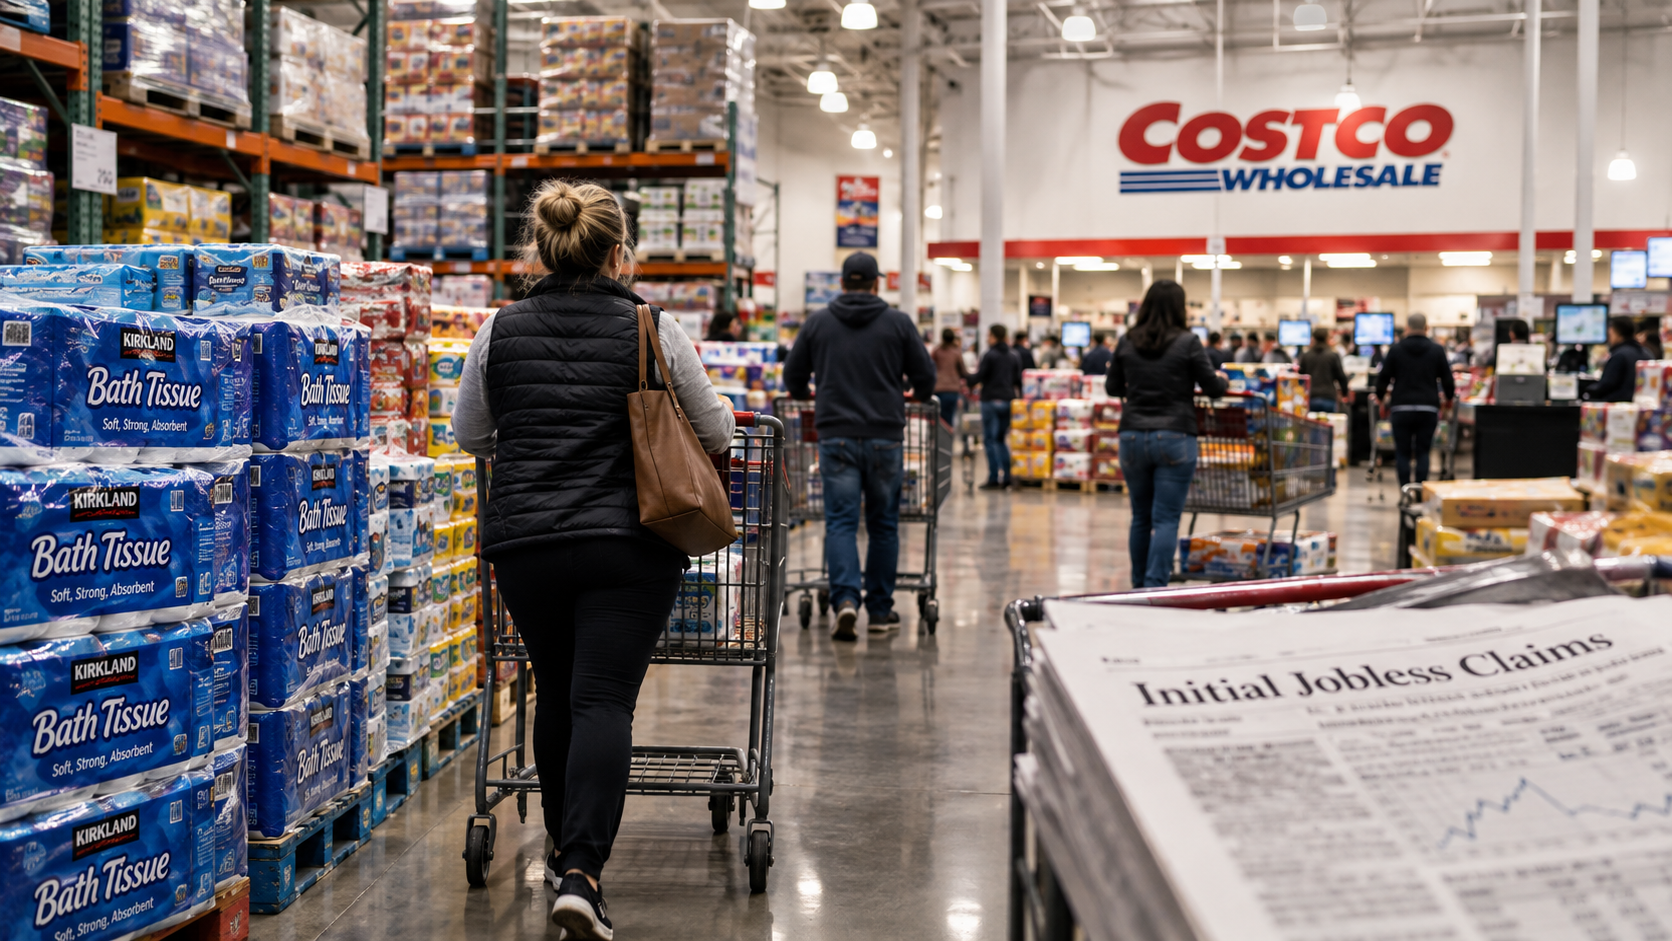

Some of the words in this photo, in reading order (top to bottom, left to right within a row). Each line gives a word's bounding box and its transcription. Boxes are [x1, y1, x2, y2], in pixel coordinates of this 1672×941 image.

[1118, 102, 1454, 165] COSTCO
[1220, 164, 1443, 191] WHOLESALE
[123, 332, 174, 351] KIRKLAND
[87, 366, 143, 406] Bath
[146, 371, 202, 408] Tissue
[301, 373, 324, 406] Bath
[324, 374, 350, 405] Tissue
[102, 418, 121, 432] Soft,
[122, 418, 150, 433] Strong,
[151, 419, 188, 432] Absorbent
[74, 491, 137, 509] KIRKLAND
[299, 500, 321, 534] Bath
[322, 498, 347, 529] Tissue
[31, 532, 98, 579] Bath
[101, 530, 171, 571] Tissue
[50, 588, 73, 603] Soft,
[110, 580, 155, 596] Absorbent
[298, 622, 321, 659] Bath
[321, 619, 346, 650] Tissue
[74, 656, 136, 681] KIRKLAND
[1130, 673, 1285, 706] Initial
[1289, 664, 1453, 697] Jobless
[1459, 633, 1614, 678] Claims
[32, 702, 98, 754] Bath
[101, 697, 170, 738] Tissue
[52, 761, 74, 778] Soft,
[109, 741, 153, 763] Absorbent
[297, 743, 320, 784] Bath
[75, 814, 137, 847] KIRKLAND
[34, 866, 100, 926] Bath
[102, 852, 170, 900] Tissue
[54, 926, 76, 941] Soft,
[111, 897, 154, 923] Absorbent
